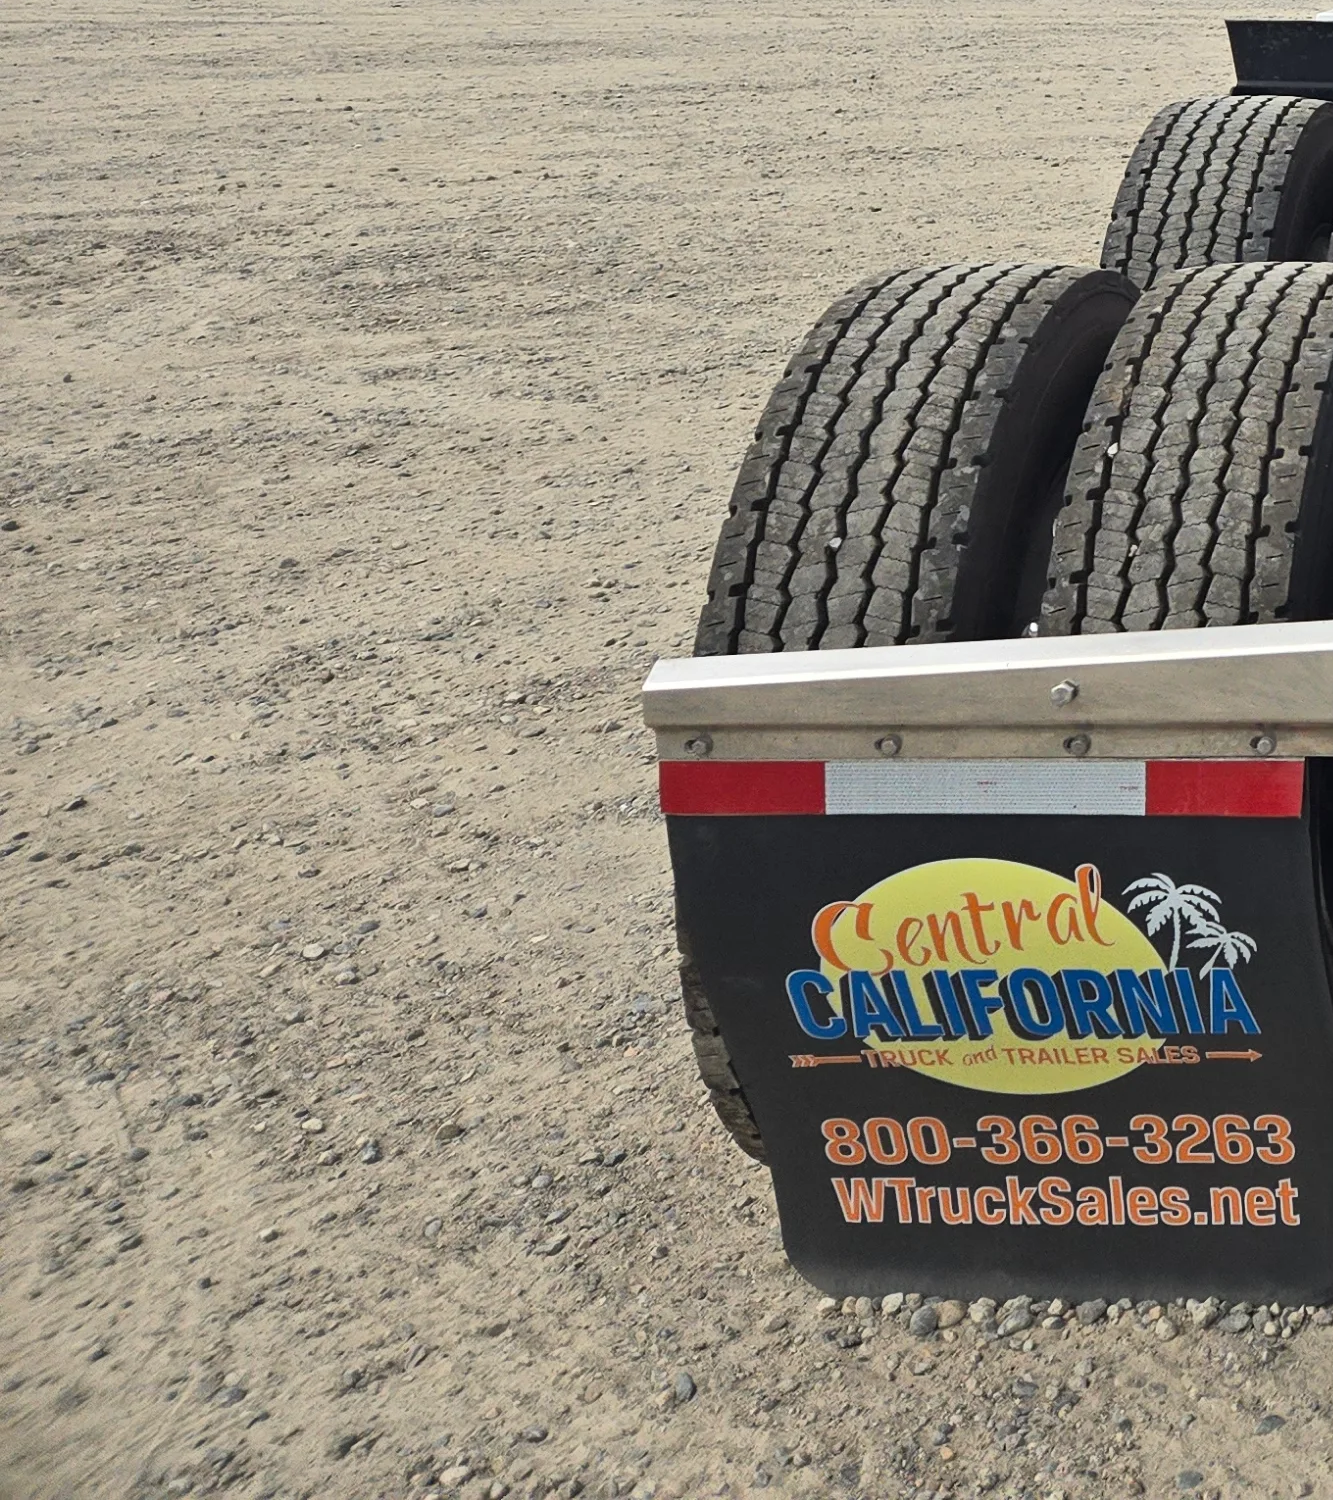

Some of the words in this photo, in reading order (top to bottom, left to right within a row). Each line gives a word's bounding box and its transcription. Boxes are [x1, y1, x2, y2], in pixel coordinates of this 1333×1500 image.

[812, 863, 1115, 977] Central
[785, 966, 1262, 1042] CALIFORNIA
[861, 1047, 950, 1069] TRUCK
[962, 1043, 998, 1067] and
[1001, 1046, 1109, 1066] TRAILER
[1116, 1045, 1201, 1065] SALES
[821, 1113, 1296, 1166] 800-366-3263
[831, 1175, 1301, 1227] WTruckSales.net
